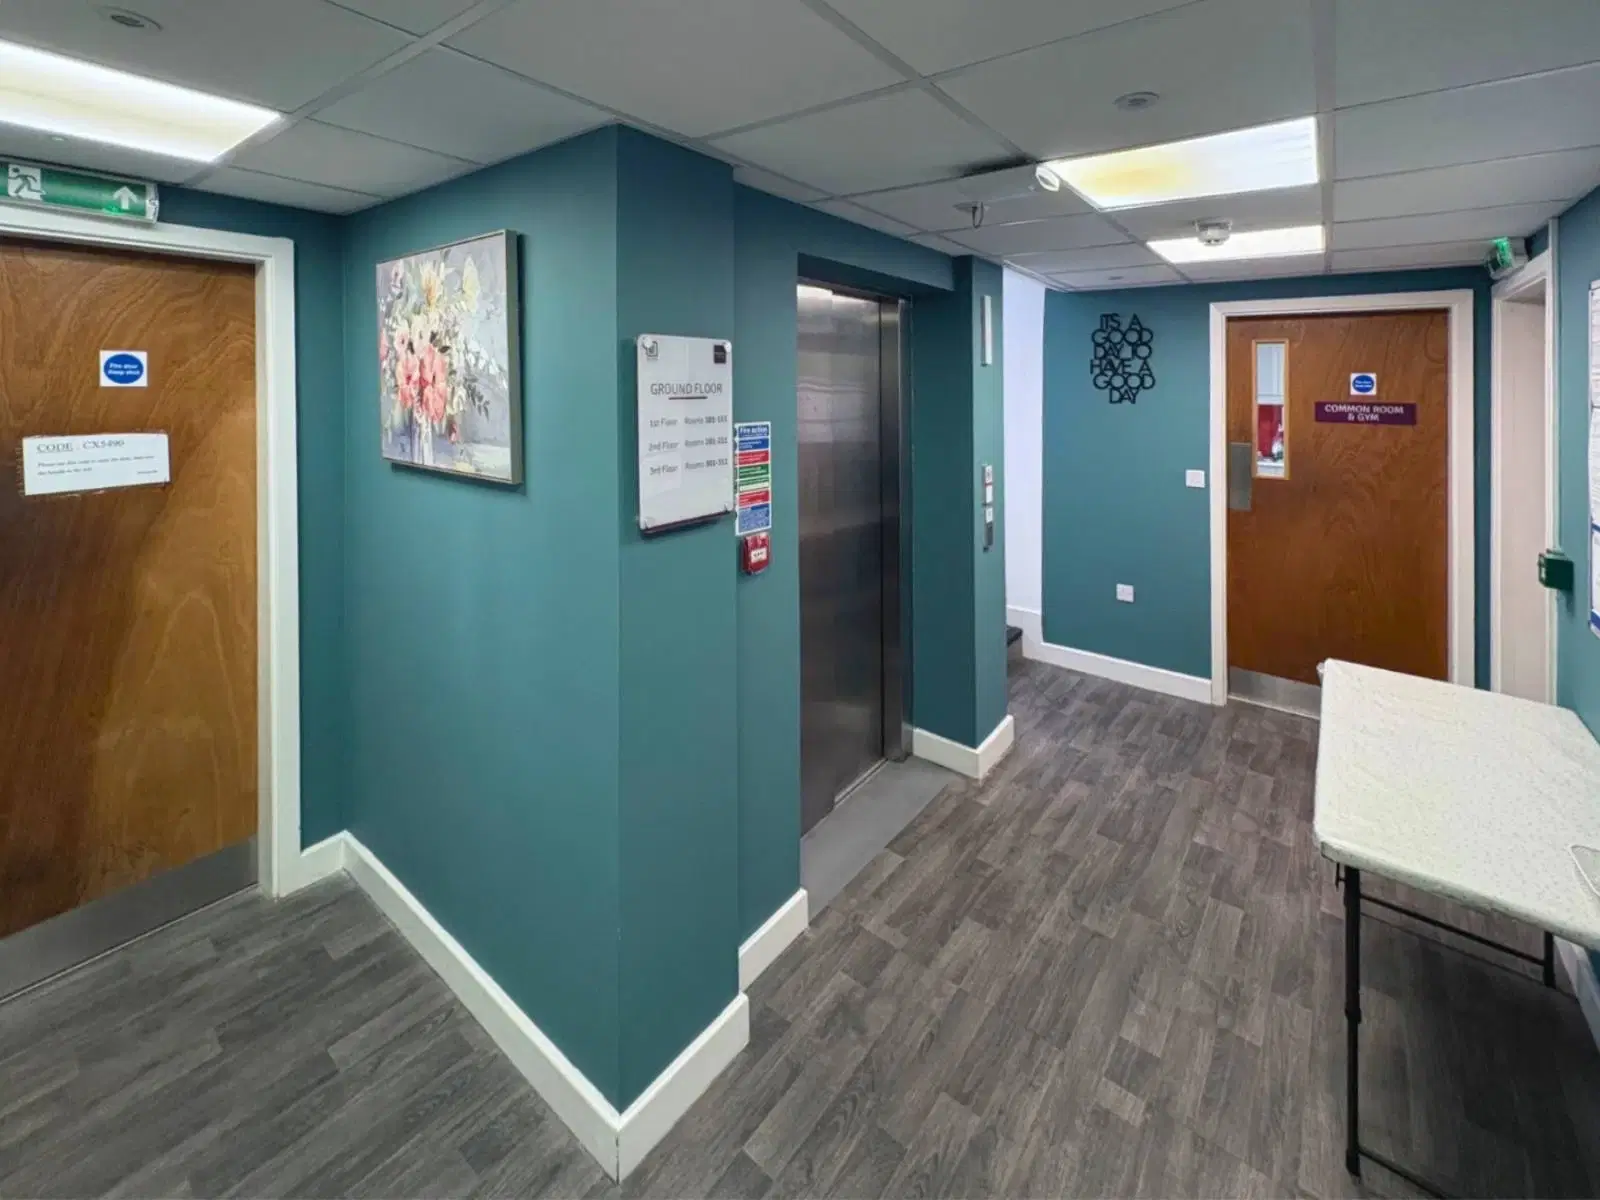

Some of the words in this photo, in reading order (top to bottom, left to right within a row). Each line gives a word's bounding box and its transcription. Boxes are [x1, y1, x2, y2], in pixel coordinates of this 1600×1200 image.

[1129, 312, 1142, 329] A
[1091, 327, 1154, 345] GOOD
[1094, 343, 1124, 360] DAY
[1129, 343, 1152, 360] TO
[1089, 358, 1132, 375] HAVE
[1139, 358, 1153, 375] A
[1092, 373, 1156, 390] GOOD
[650, 382, 692, 396] GROUND
[694, 382, 723, 395] FLOOR
[1109, 388, 1141, 405] DAY
[1324, 404, 1370, 414] COMMON
[1372, 405, 1404, 414] ROOM
[661, 417, 678, 426] Floor
[1347, 413, 1355, 421] &
[1357, 413, 1380, 422] GYM
[36, 442, 73, 453] CODE
[648, 441, 661, 451] 2nd
[662, 440, 680, 450] Floor
[662, 464, 678, 473] Floor
